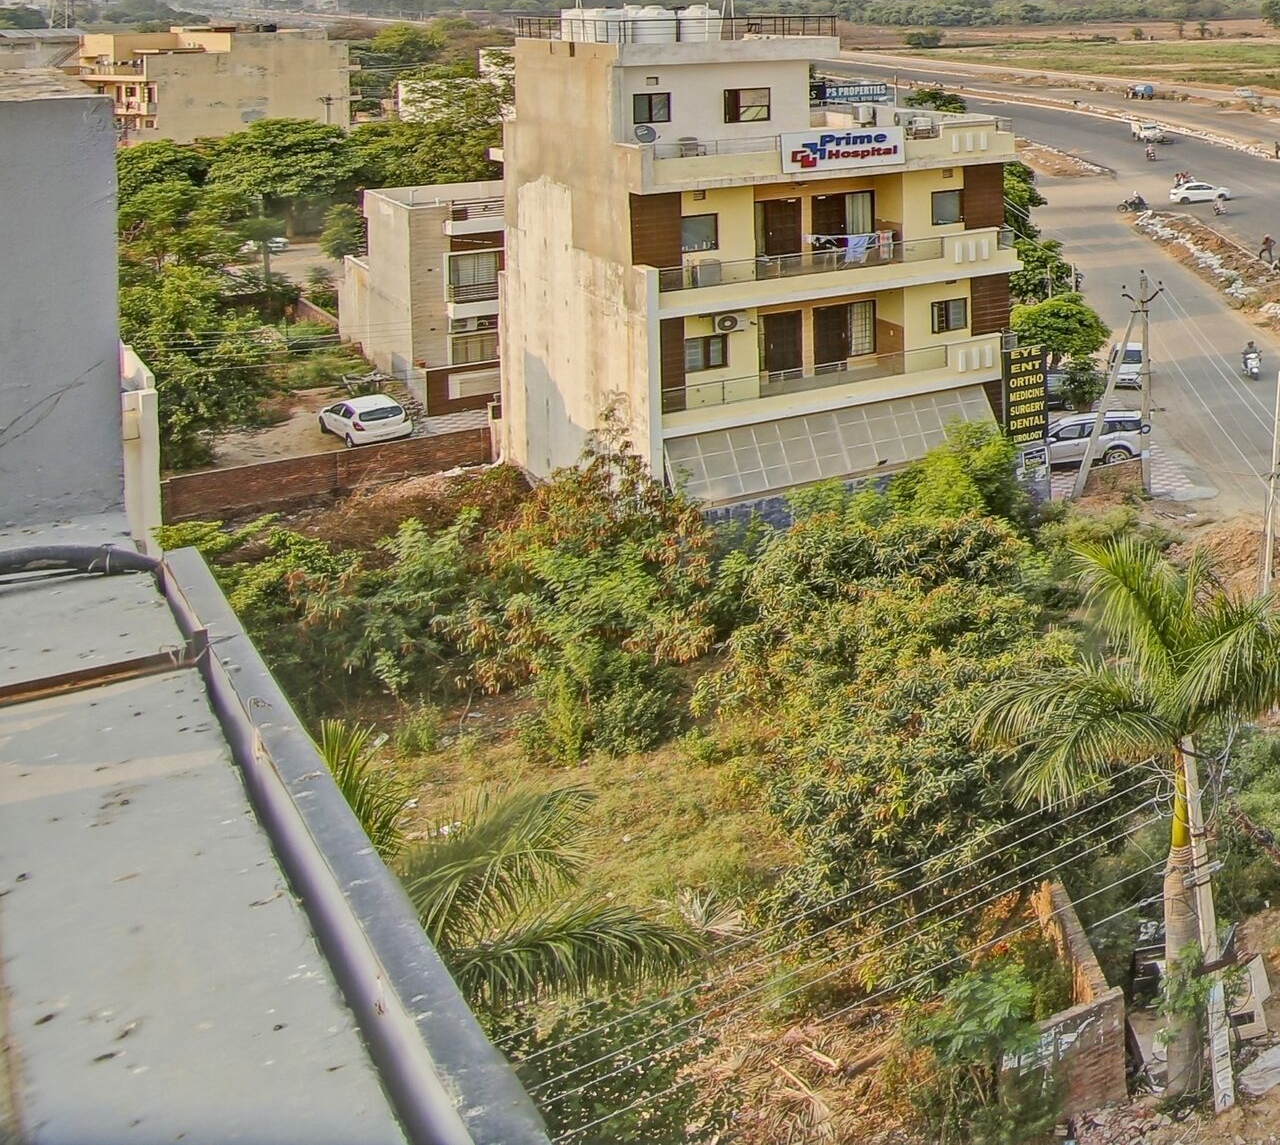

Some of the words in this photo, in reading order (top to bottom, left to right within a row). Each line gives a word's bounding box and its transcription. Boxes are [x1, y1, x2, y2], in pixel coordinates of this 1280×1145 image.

[826, 87, 837, 97] PS
[838, 85, 886, 96] PROPERTIES
[820, 133, 887, 147] Prime
[828, 145, 898, 159] Hospital
[1010, 347, 1042, 360] EYE
[1010, 360, 1042, 374] ENT
[1009, 373, 1044, 388] ORTHO
[1009, 387, 1045, 403] MEDICINE
[1010, 400, 1045, 416] SURGERY
[1010, 415, 1046, 431] DENTAL
[1013, 430, 1043, 443] UROLOGY
